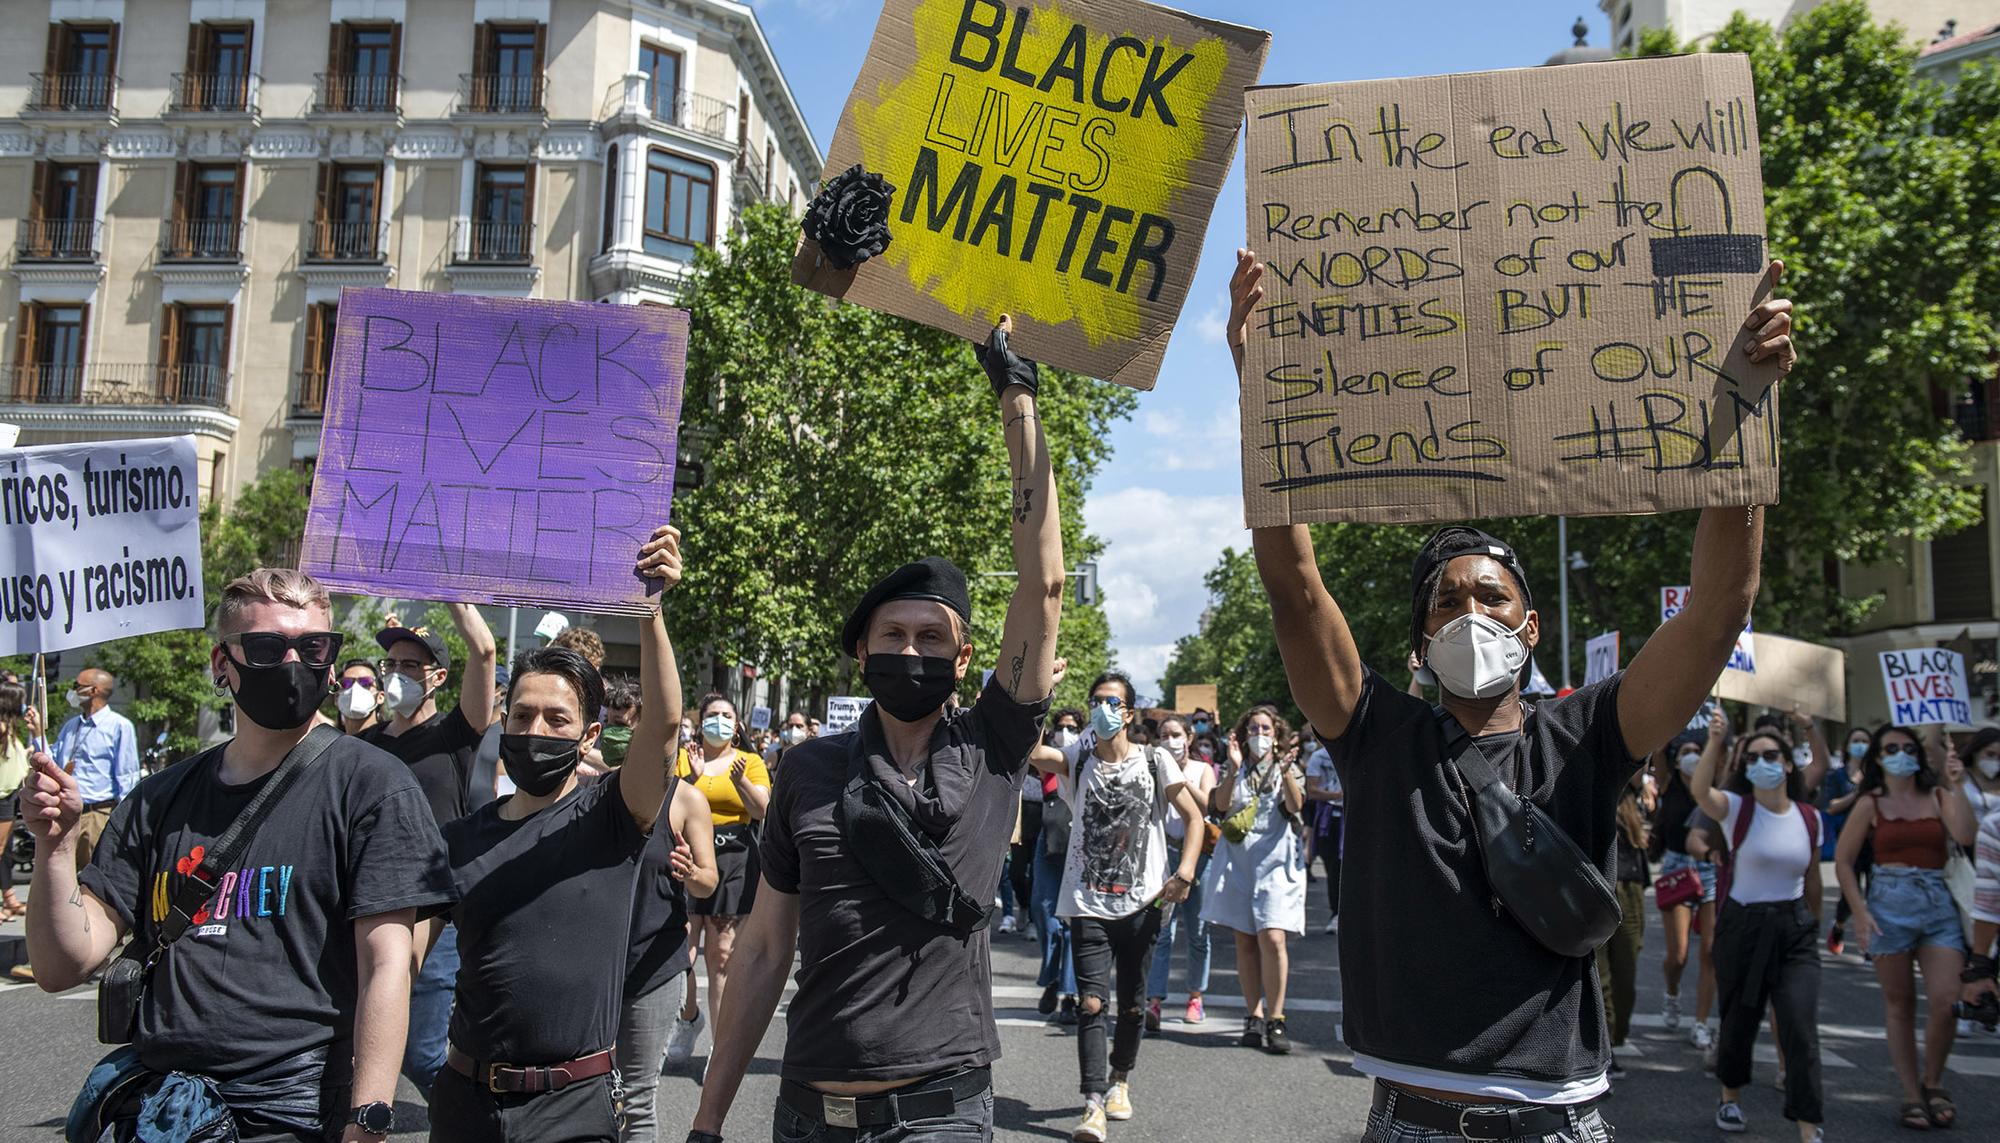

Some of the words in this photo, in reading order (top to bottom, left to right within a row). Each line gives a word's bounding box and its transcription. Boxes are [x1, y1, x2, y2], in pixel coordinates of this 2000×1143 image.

[949, 0, 1195, 127] BLACK
[924, 73, 1116, 193] LIVES
[1257, 102, 1363, 174] In
[1368, 102, 1470, 170] the
[1487, 108, 1568, 159] end
[899, 145, 1176, 302] MATTER
[1262, 181, 1490, 242] Remember
[1507, 191, 1590, 228] not
[1598, 165, 1692, 231] the
[1267, 246, 1465, 290] WORDS
[1494, 236, 1554, 276] of
[1567, 232, 1636, 272] our
[1256, 297, 1458, 341] ENEMIES
[1498, 283, 1602, 334] BUT
[1622, 275, 1723, 320] THE
[360, 314, 661, 416] BLACK
[1265, 350, 1472, 405] Silence
[1503, 347, 1563, 390] of
[1591, 331, 1739, 387] OUR
[347, 391, 665, 484] LIVES
[1260, 400, 1507, 480] Friends
[1553, 384, 1778, 474] #BLM
[2, 460, 78, 531] ricos,
[82, 453, 191, 518] turismo.
[330, 479, 648, 586] MATTER
[0, 573, 54, 623] uso
[59, 569, 75, 634] y
[83, 545, 194, 612] racismo.
[1884, 650, 1958, 678] BLACK
[1890, 675, 1954, 702] LIVES
[830, 701, 857, 713] Trump,
[1895, 698, 1973, 726] MATTER
[152, 864, 294, 922] MCKEY
